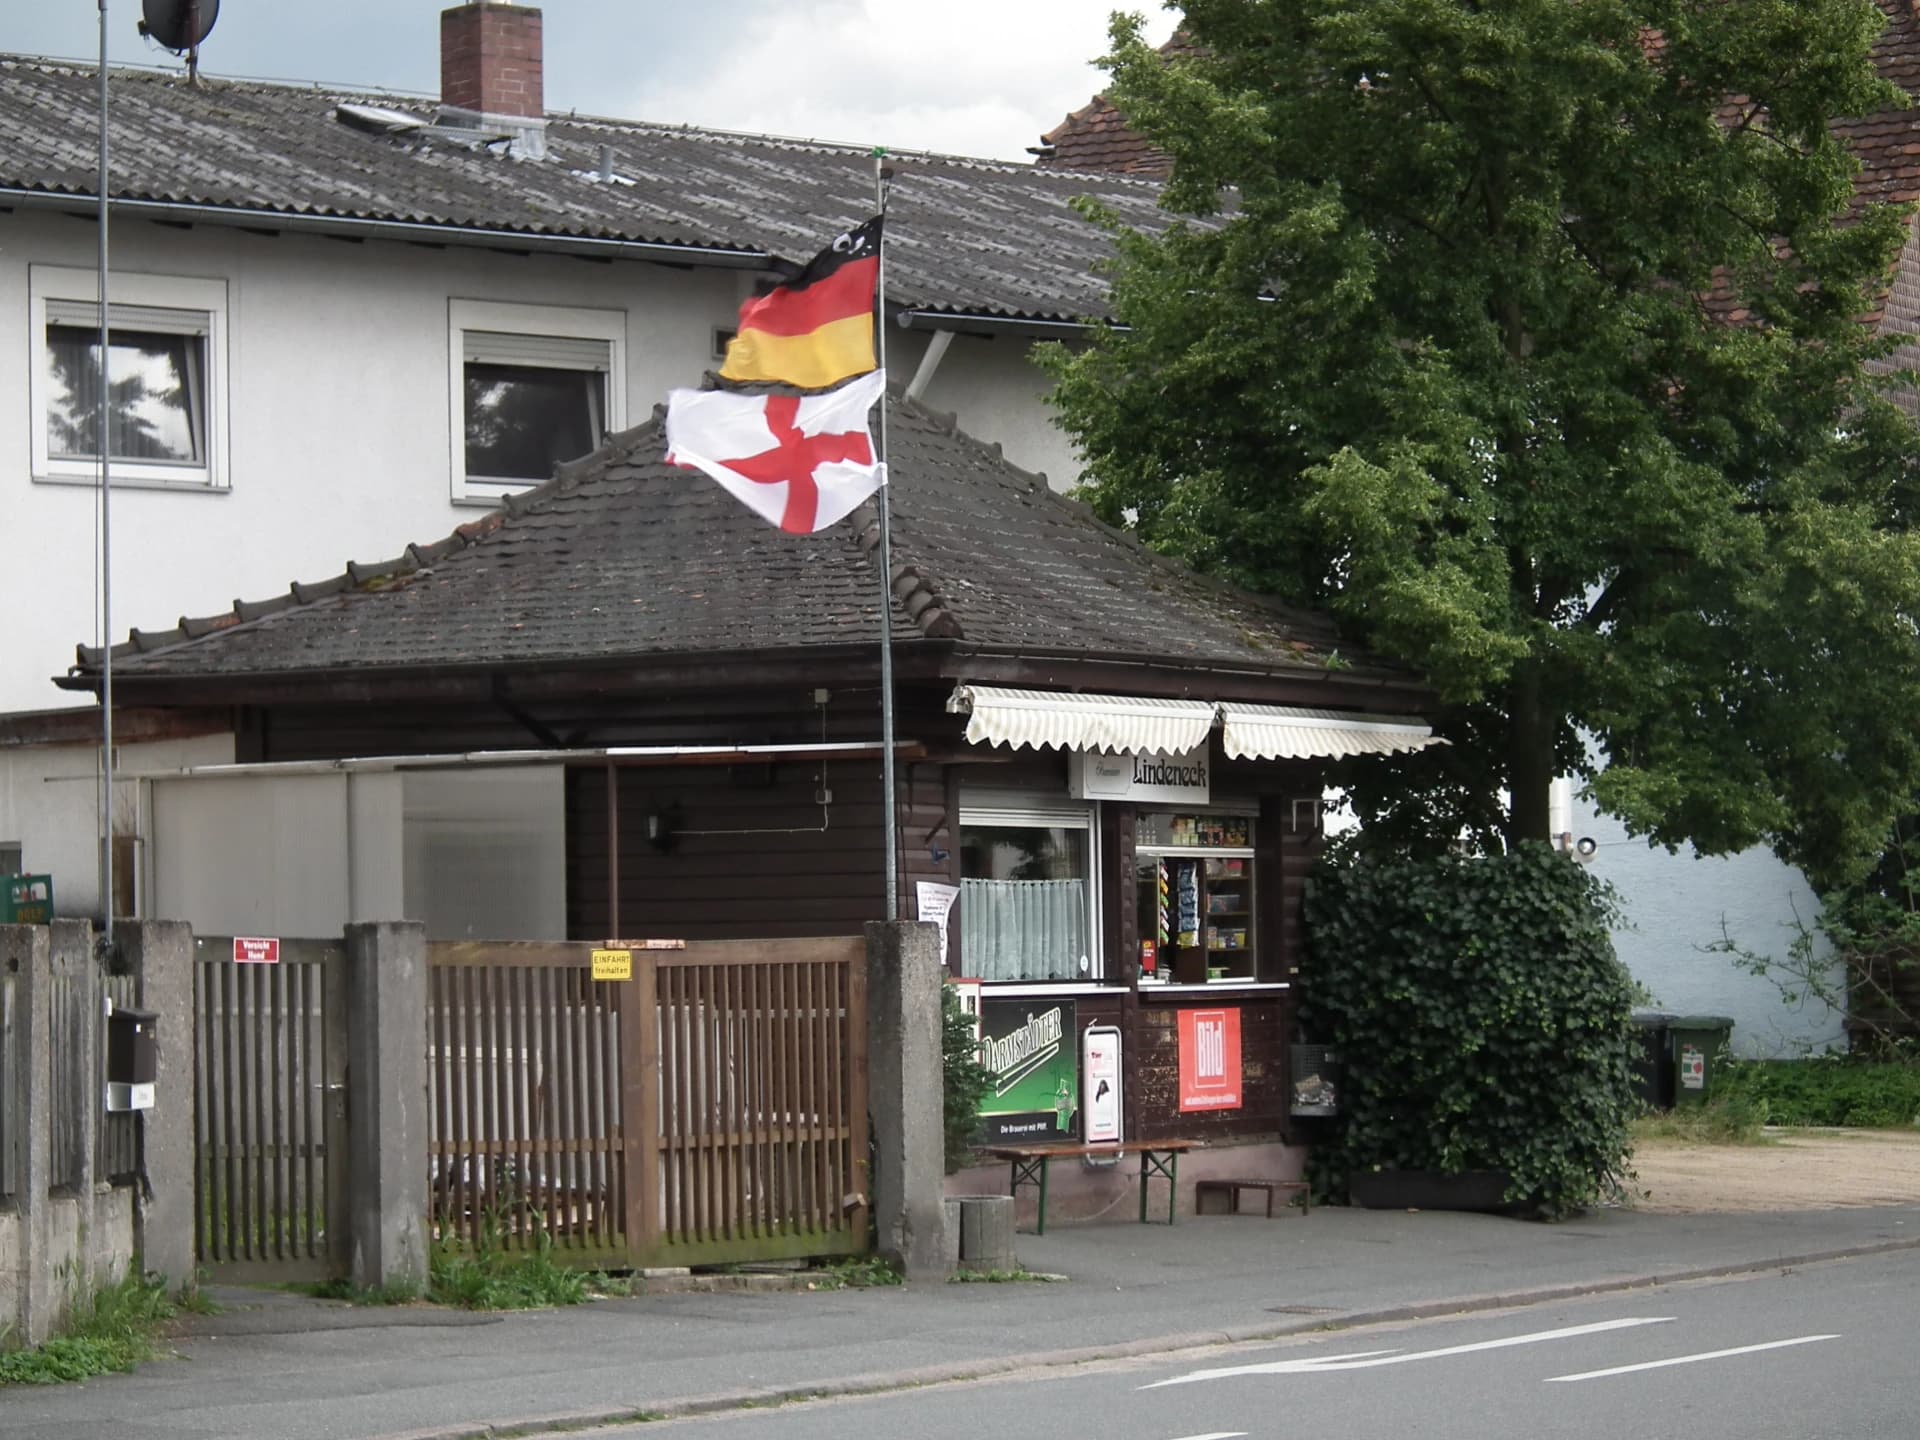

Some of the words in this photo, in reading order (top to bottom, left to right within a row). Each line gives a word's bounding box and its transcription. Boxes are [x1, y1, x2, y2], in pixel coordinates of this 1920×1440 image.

[1133, 757, 1207, 787] Lindeneck
[593, 955, 629, 964] EINFAHRT
[595, 966, 628, 974] freihalten
